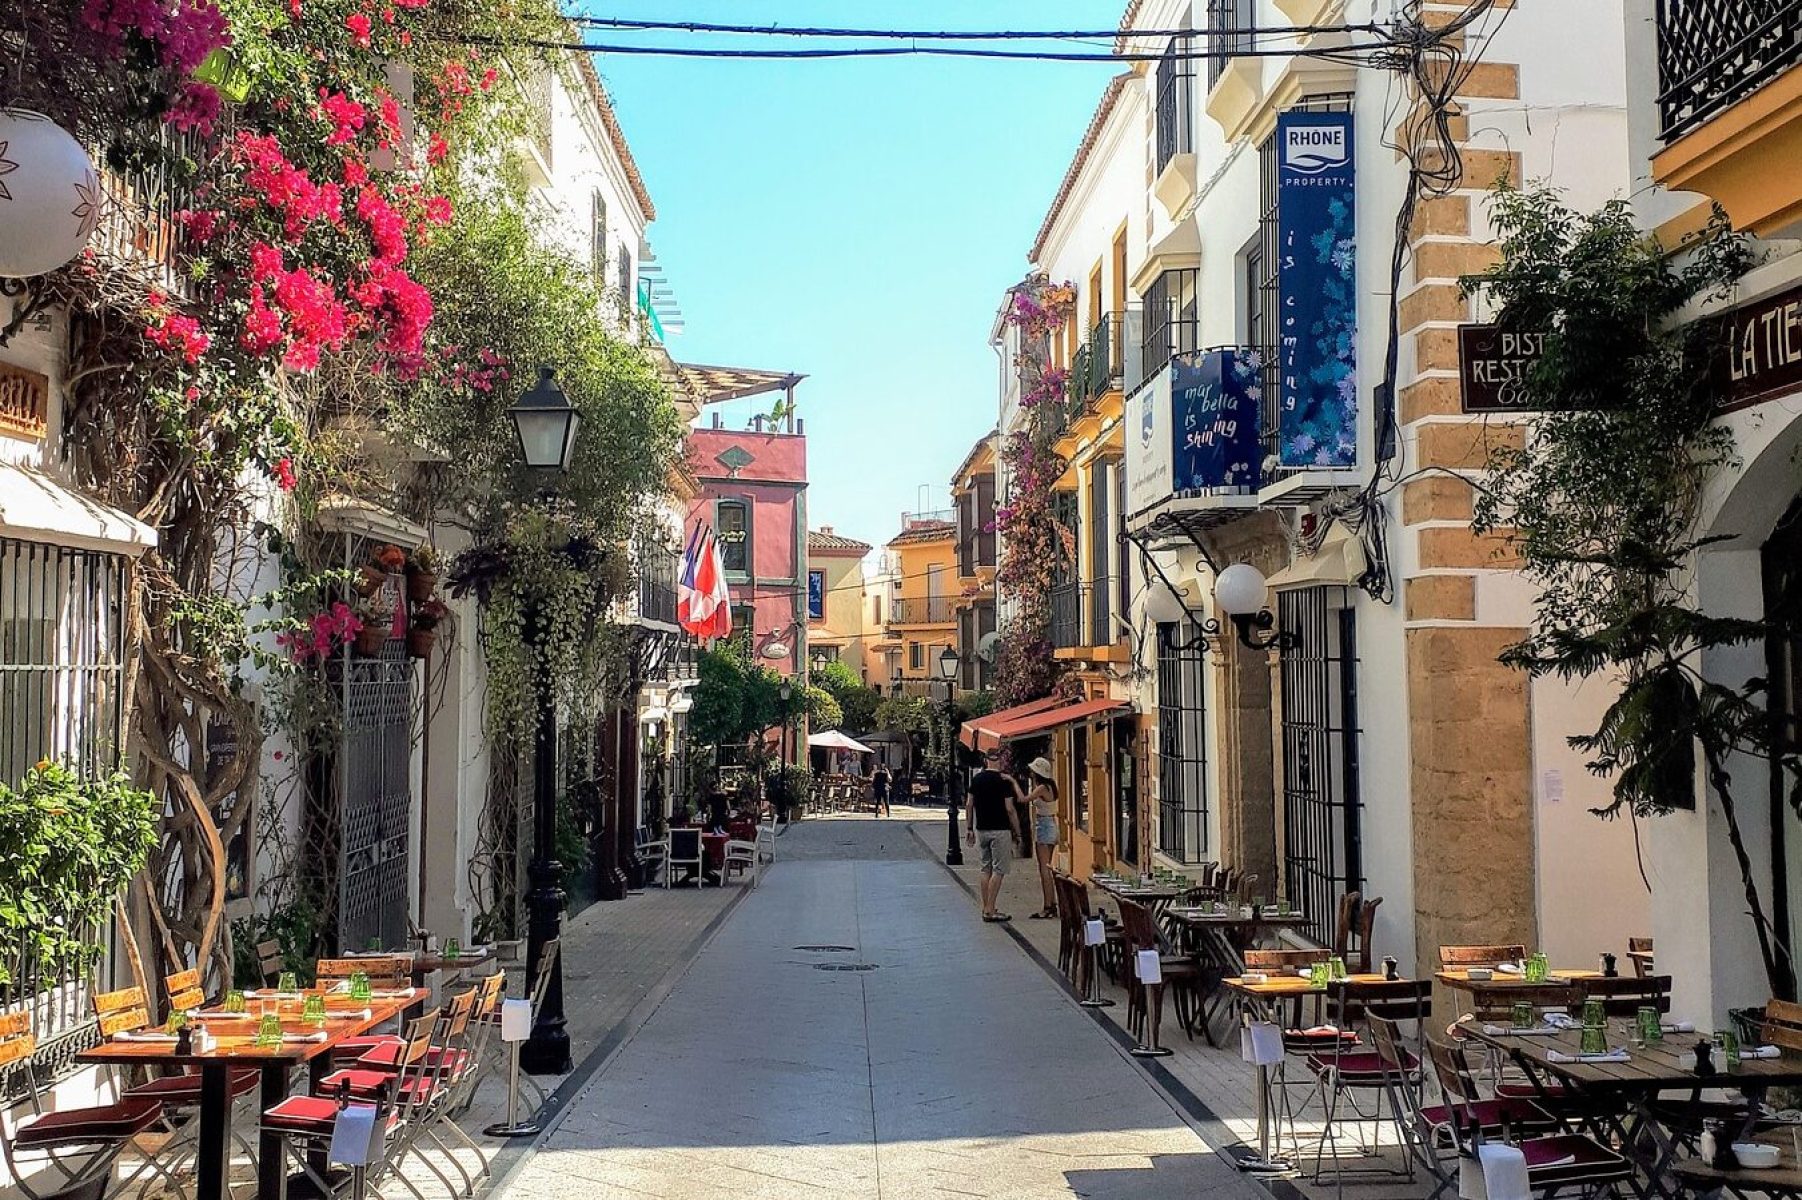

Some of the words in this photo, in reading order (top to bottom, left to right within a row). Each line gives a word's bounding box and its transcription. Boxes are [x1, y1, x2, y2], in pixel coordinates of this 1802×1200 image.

[1286, 178, 1345, 187] PROPERTY
[1502, 333, 1547, 355] BIST
[1730, 318, 1757, 380] LA
[1761, 302, 1802, 369] TIE
